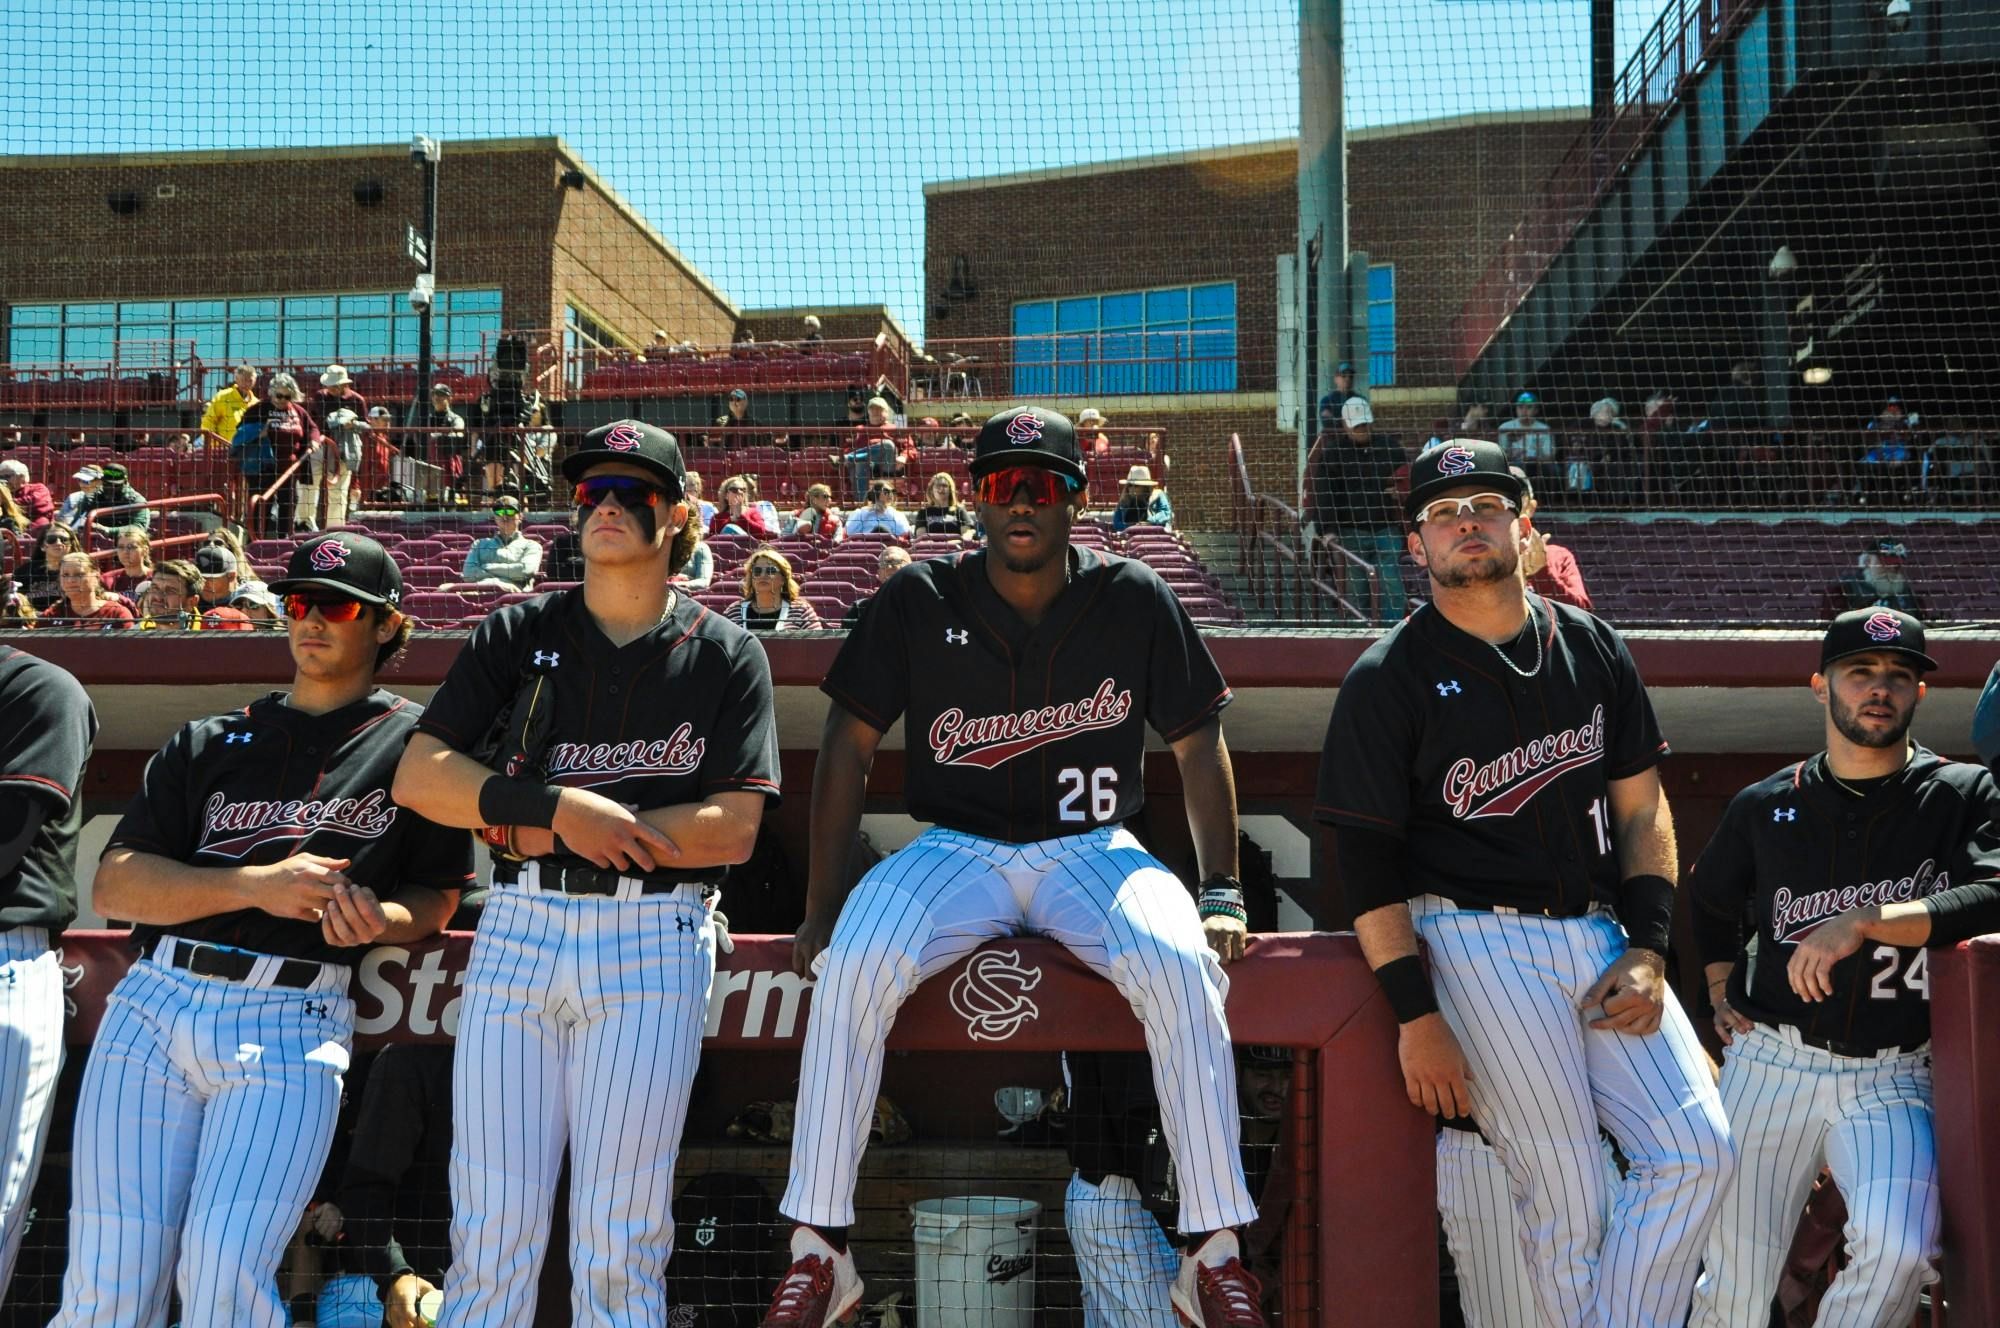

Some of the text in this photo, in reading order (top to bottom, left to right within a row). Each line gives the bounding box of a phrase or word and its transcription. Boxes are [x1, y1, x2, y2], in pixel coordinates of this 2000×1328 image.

[549, 721, 706, 772] mecocks
[928, 677, 1133, 764] Gamecocks
[1442, 703, 1606, 819] Gamecock
[1056, 766, 1119, 822] 26
[1587, 797, 1612, 856] 1
[1870, 945, 1930, 1001] 24
[703, 969, 818, 1039] rm
